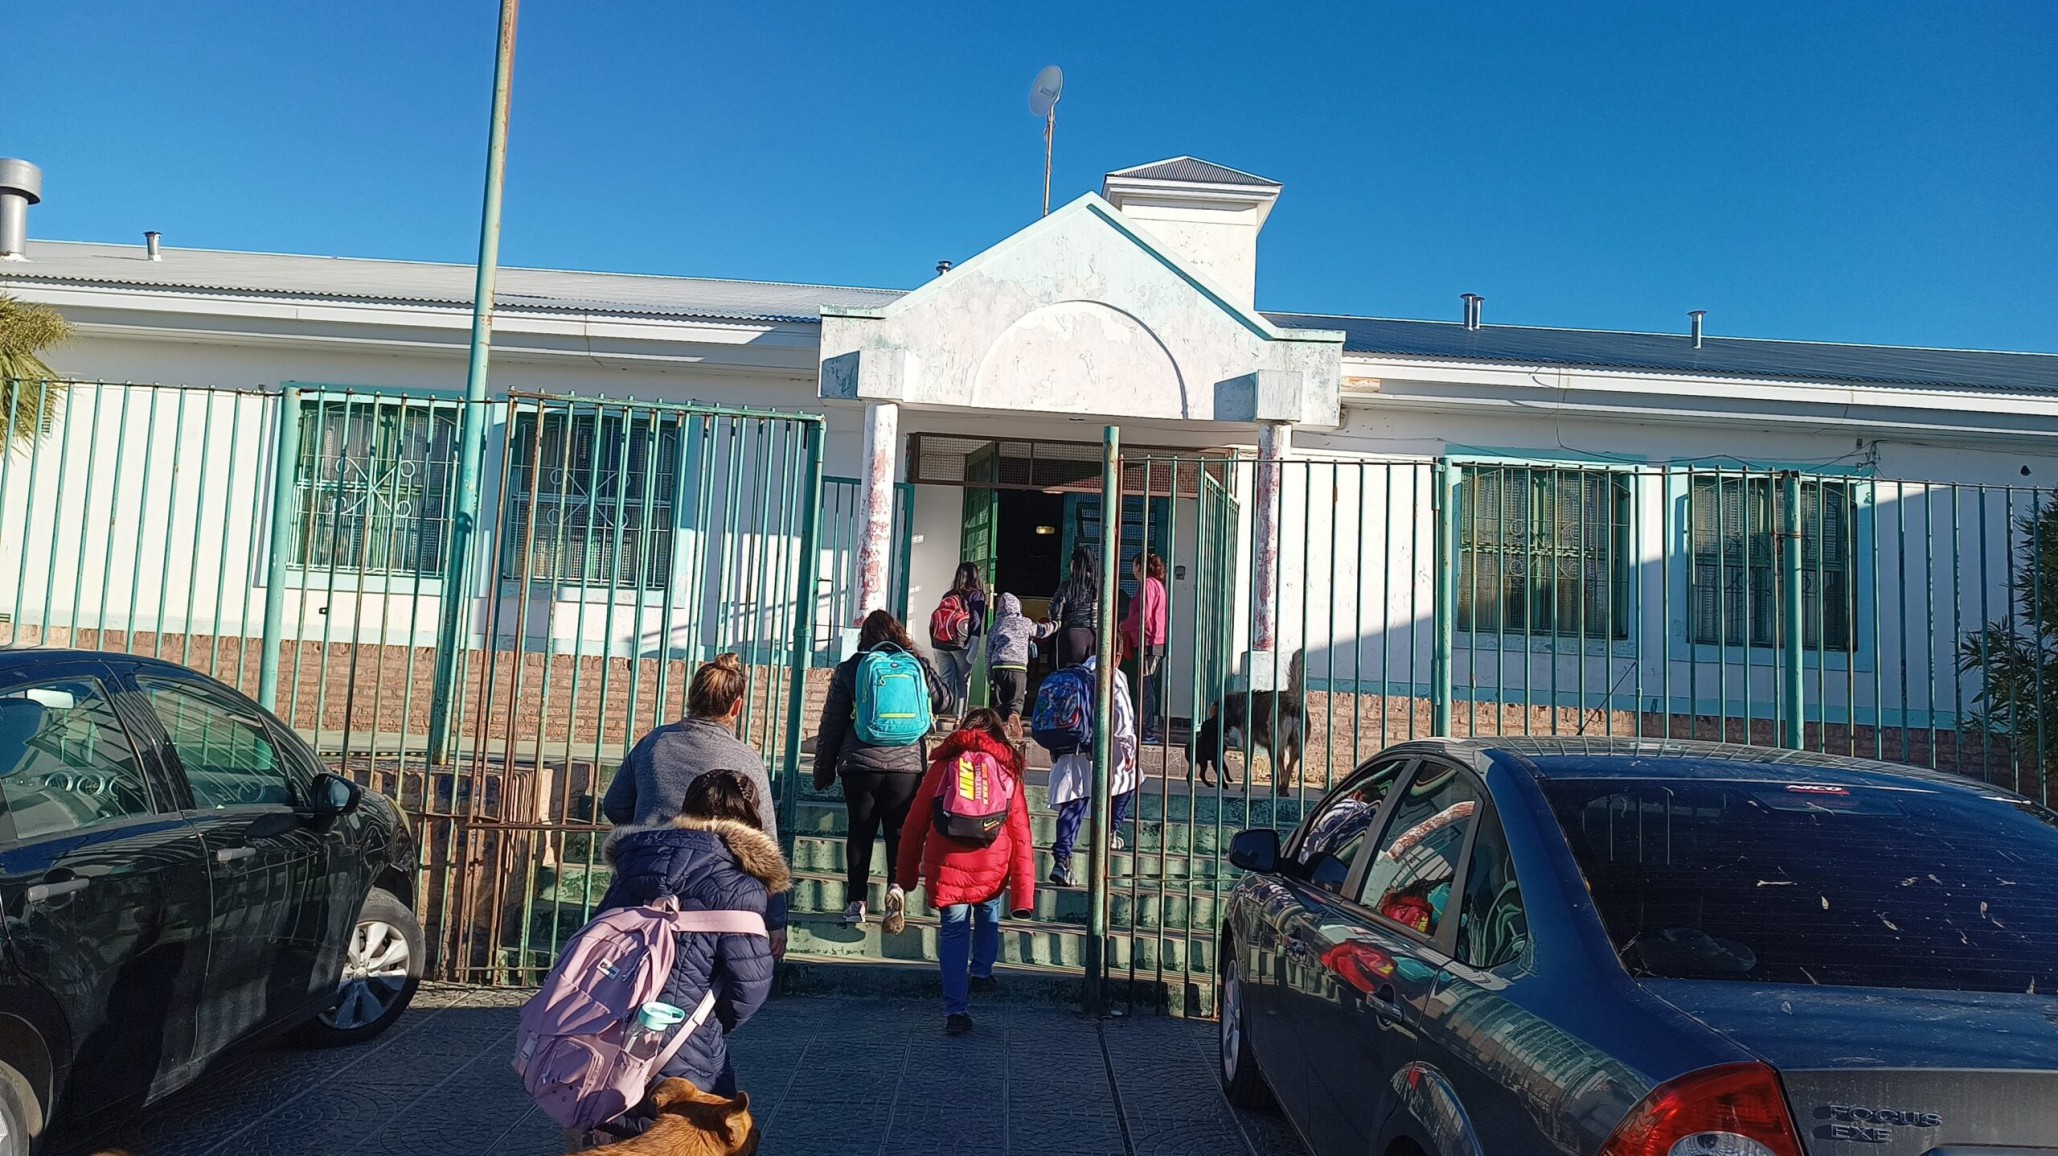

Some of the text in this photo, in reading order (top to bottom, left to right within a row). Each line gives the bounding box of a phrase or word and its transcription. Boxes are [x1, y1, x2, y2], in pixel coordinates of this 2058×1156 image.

[958, 757, 975, 801] NIKE
[1829, 1104, 1943, 1125] FOCUS
[1830, 1123, 1893, 1142] EXE
